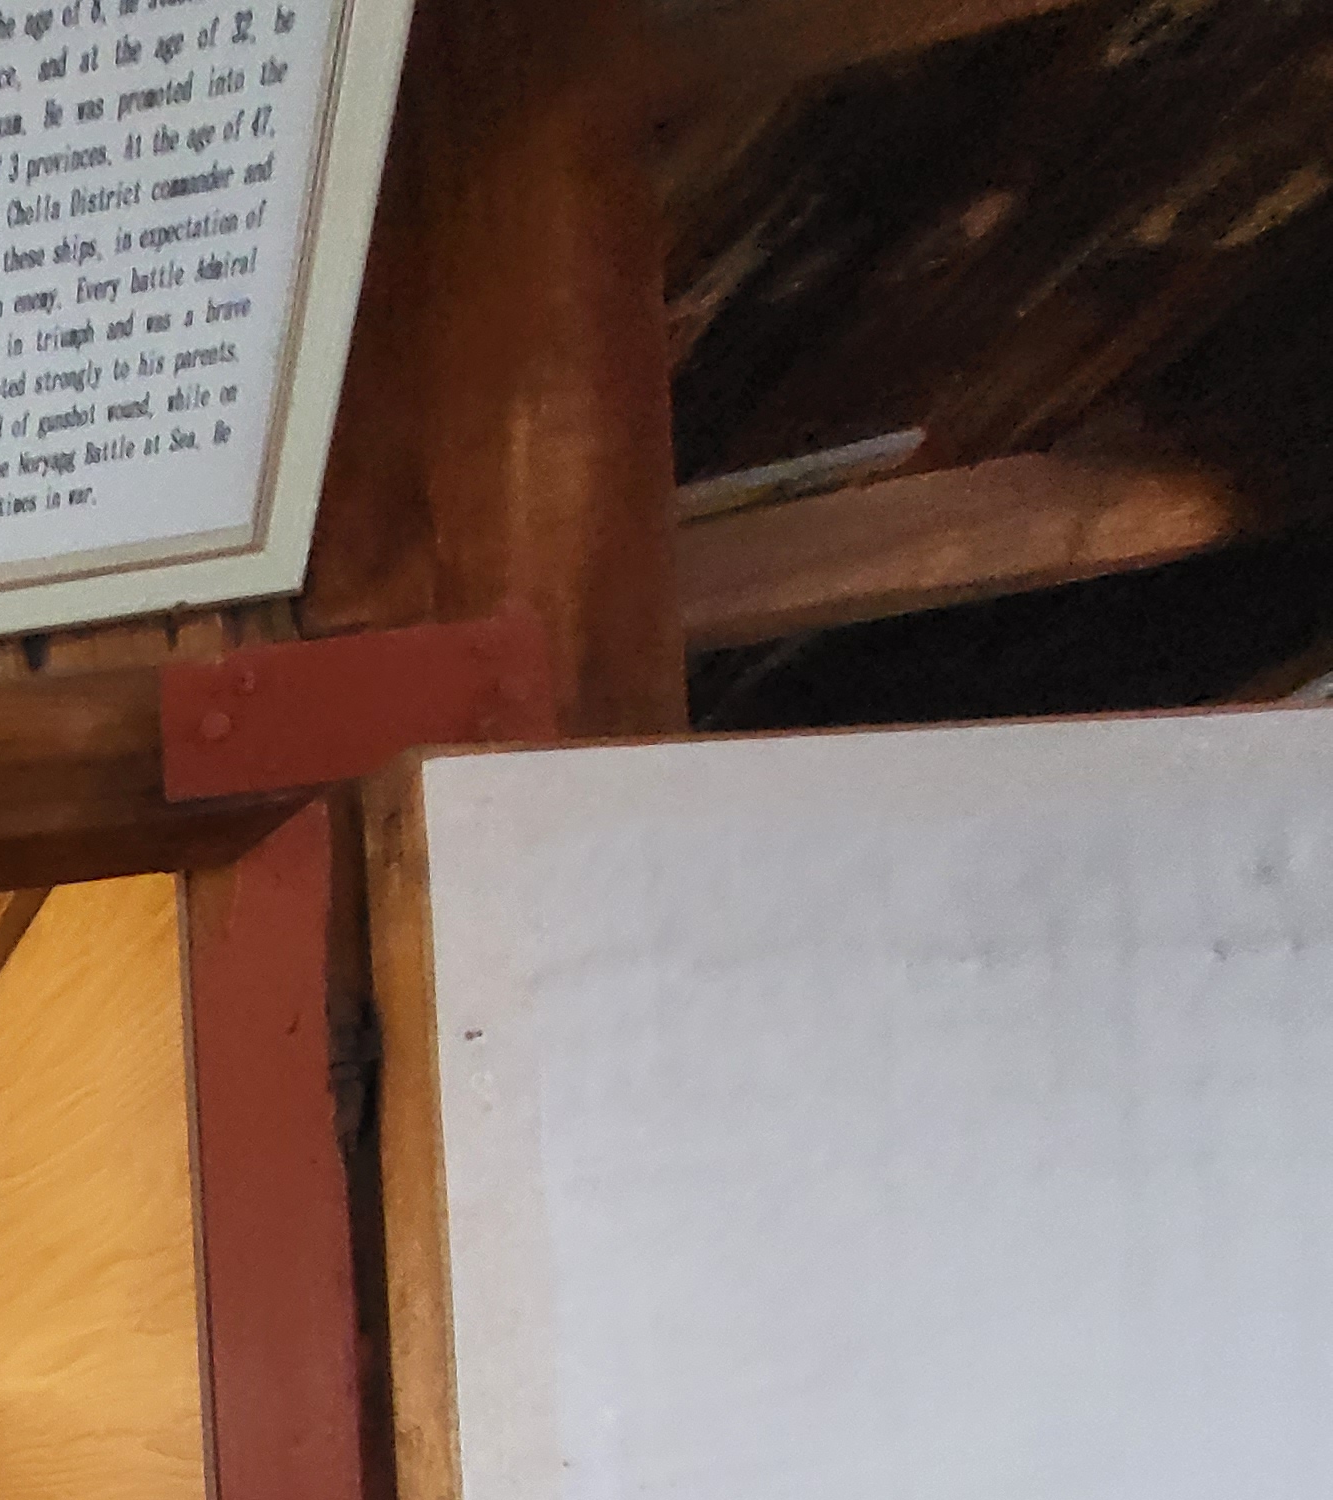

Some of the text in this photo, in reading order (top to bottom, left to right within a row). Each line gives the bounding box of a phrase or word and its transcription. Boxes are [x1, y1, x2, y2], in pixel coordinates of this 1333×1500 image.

[23, 10, 53, 41] age
[61, 2, 79, 28] of
[37, 44, 68, 83] and
[78, 43, 99, 74] at
[114, 33, 142, 68] the
[153, 31, 184, 65] age
[196, 14, 220, 50] of
[273, 7, 295, 35] he
[42, 98, 63, 130] He
[75, 96, 104, 125] was
[116, 69, 194, 122] promoted
[207, 65, 245, 98] into
[259, 54, 288, 86] the
[7, 150, 19, 184] 3
[122, 132, 141, 161] At
[152, 123, 179, 156] the
[185, 123, 216, 155] age
[222, 108, 245, 143] of
[69, 179, 141, 217] District
[150, 159, 235, 202] commander
[242, 150, 275, 185] and
[2, 244, 45, 274] these
[114, 225, 132, 255] in
[138, 208, 238, 253] expectation
[244, 197, 267, 230] of
[75, 275, 121, 304] Every
[129, 259, 184, 294] battle
[6, 331, 23, 358] in
[36, 317, 95, 353] triumph
[105, 308, 135, 341] and
[145, 311, 172, 334] was
[204, 296, 251, 324] brave
[33, 358, 102, 395] strongly
[112, 357, 130, 381] to
[136, 350, 165, 377] his
[10, 409, 30, 438] of
[36, 402, 95, 440] gunshot
[166, 382, 210, 412] while
[218, 383, 238, 405] on
[83, 434, 135, 465] Battle
[142, 433, 160, 457] at
[212, 419, 231, 445] He
